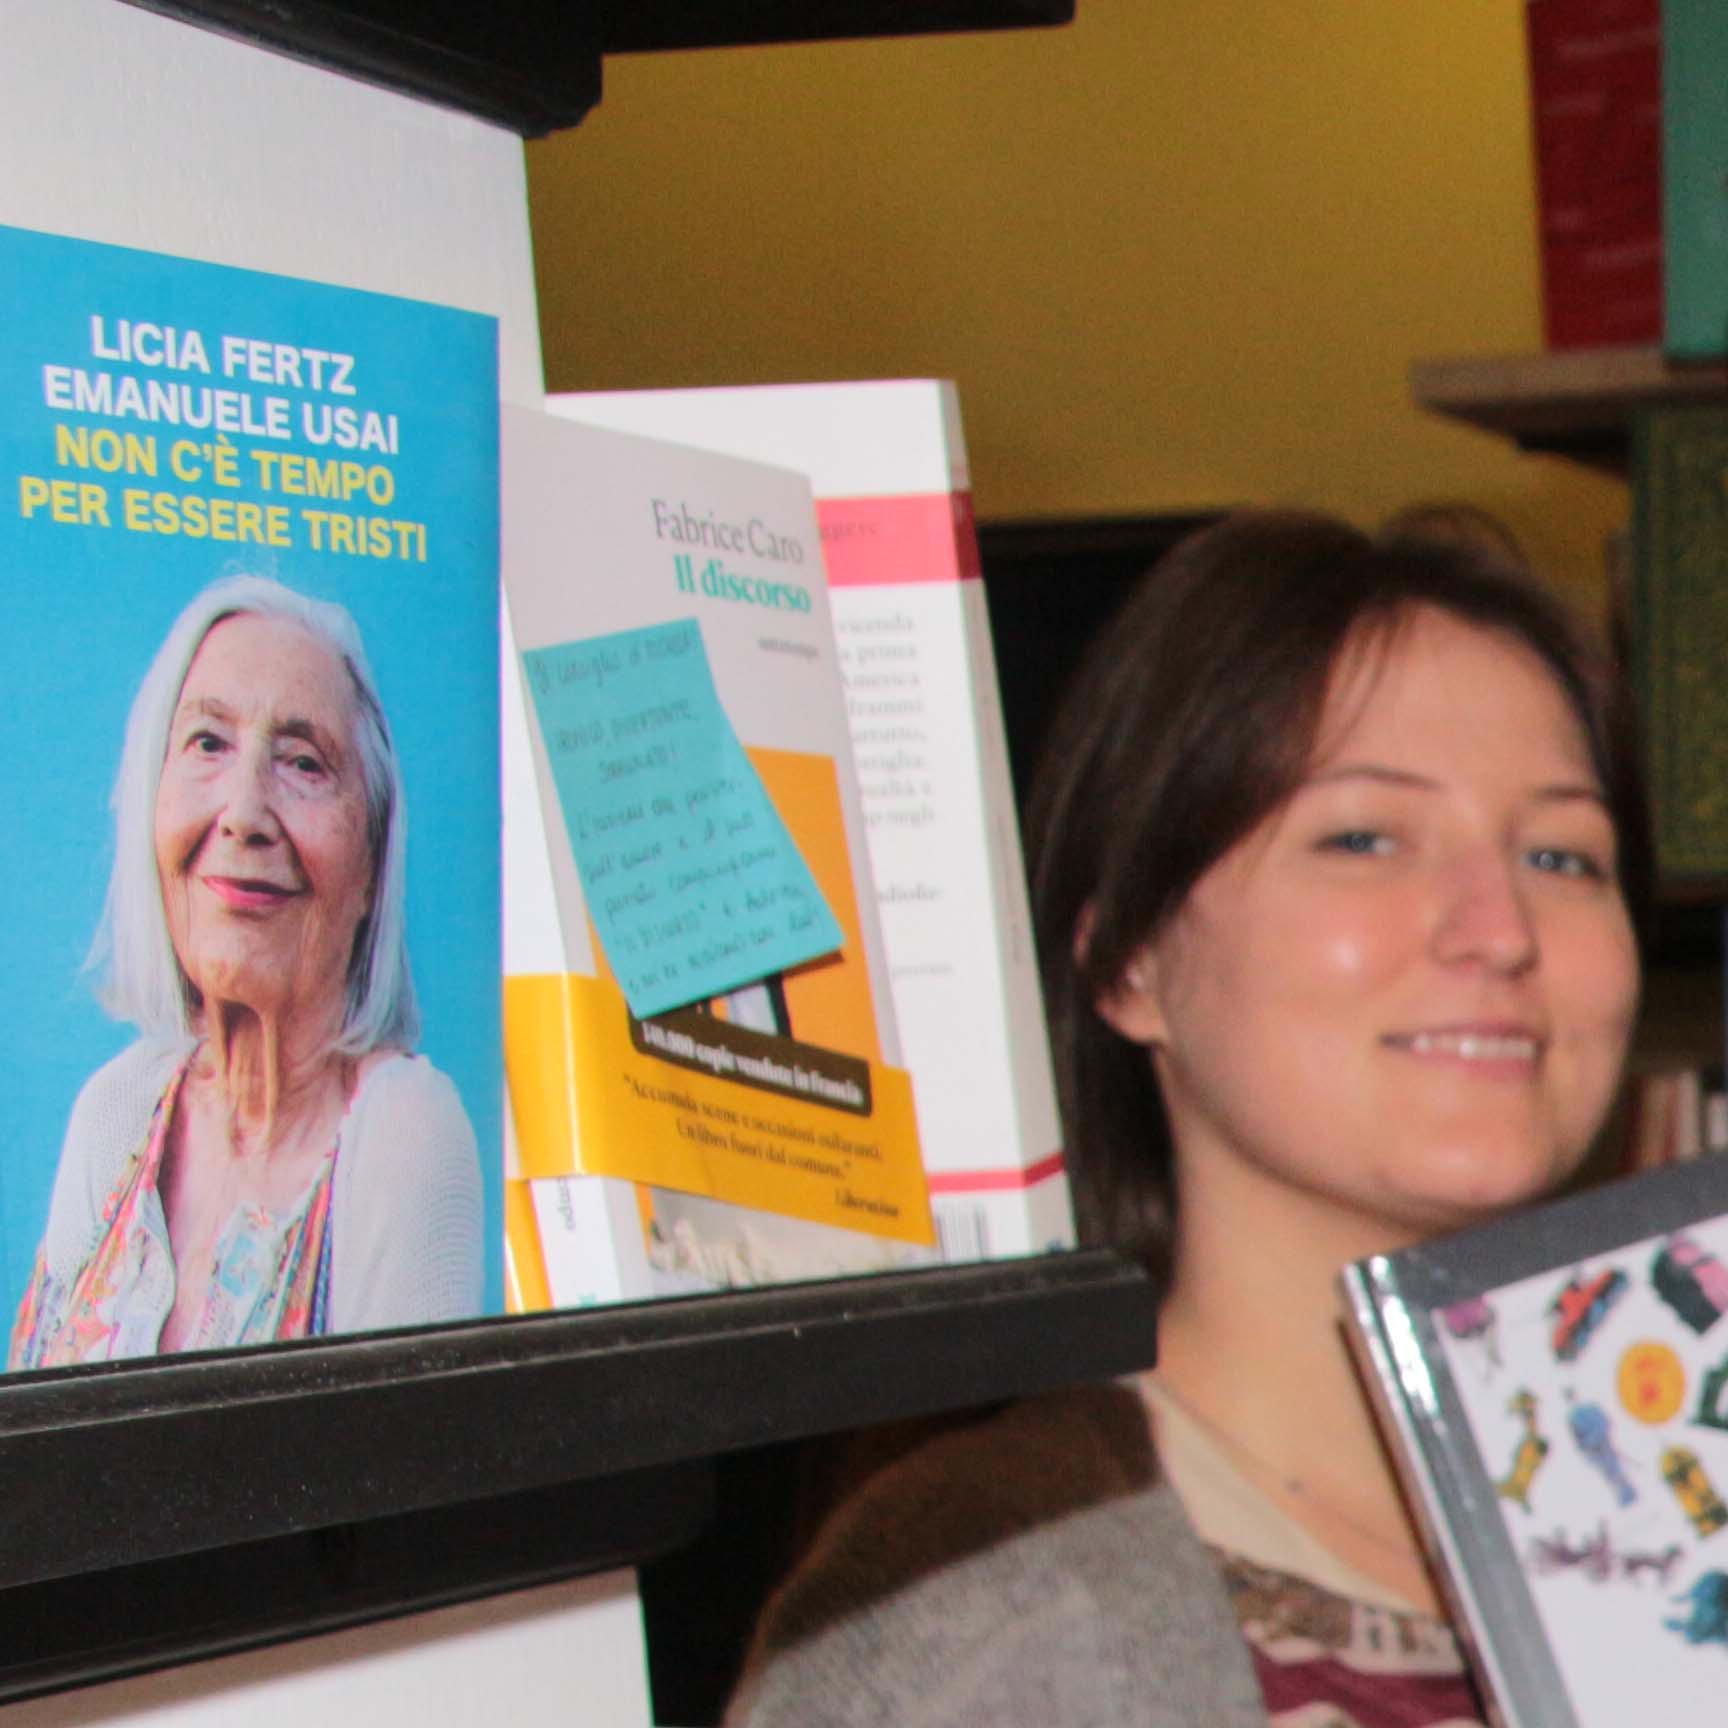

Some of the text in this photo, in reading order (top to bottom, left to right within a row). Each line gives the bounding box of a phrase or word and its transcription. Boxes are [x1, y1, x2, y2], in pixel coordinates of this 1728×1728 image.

[90, 315, 357, 395] LICIA FERTZ
[43, 364, 399, 454] EMANUELE USAI
[55, 424, 395, 506] NON C'È TEMPO
[19, 476, 428, 562] PER ESSERE TRISTI
[651, 498, 804, 565] Fabrice Caro
[673, 553, 813, 615] Il discorso
